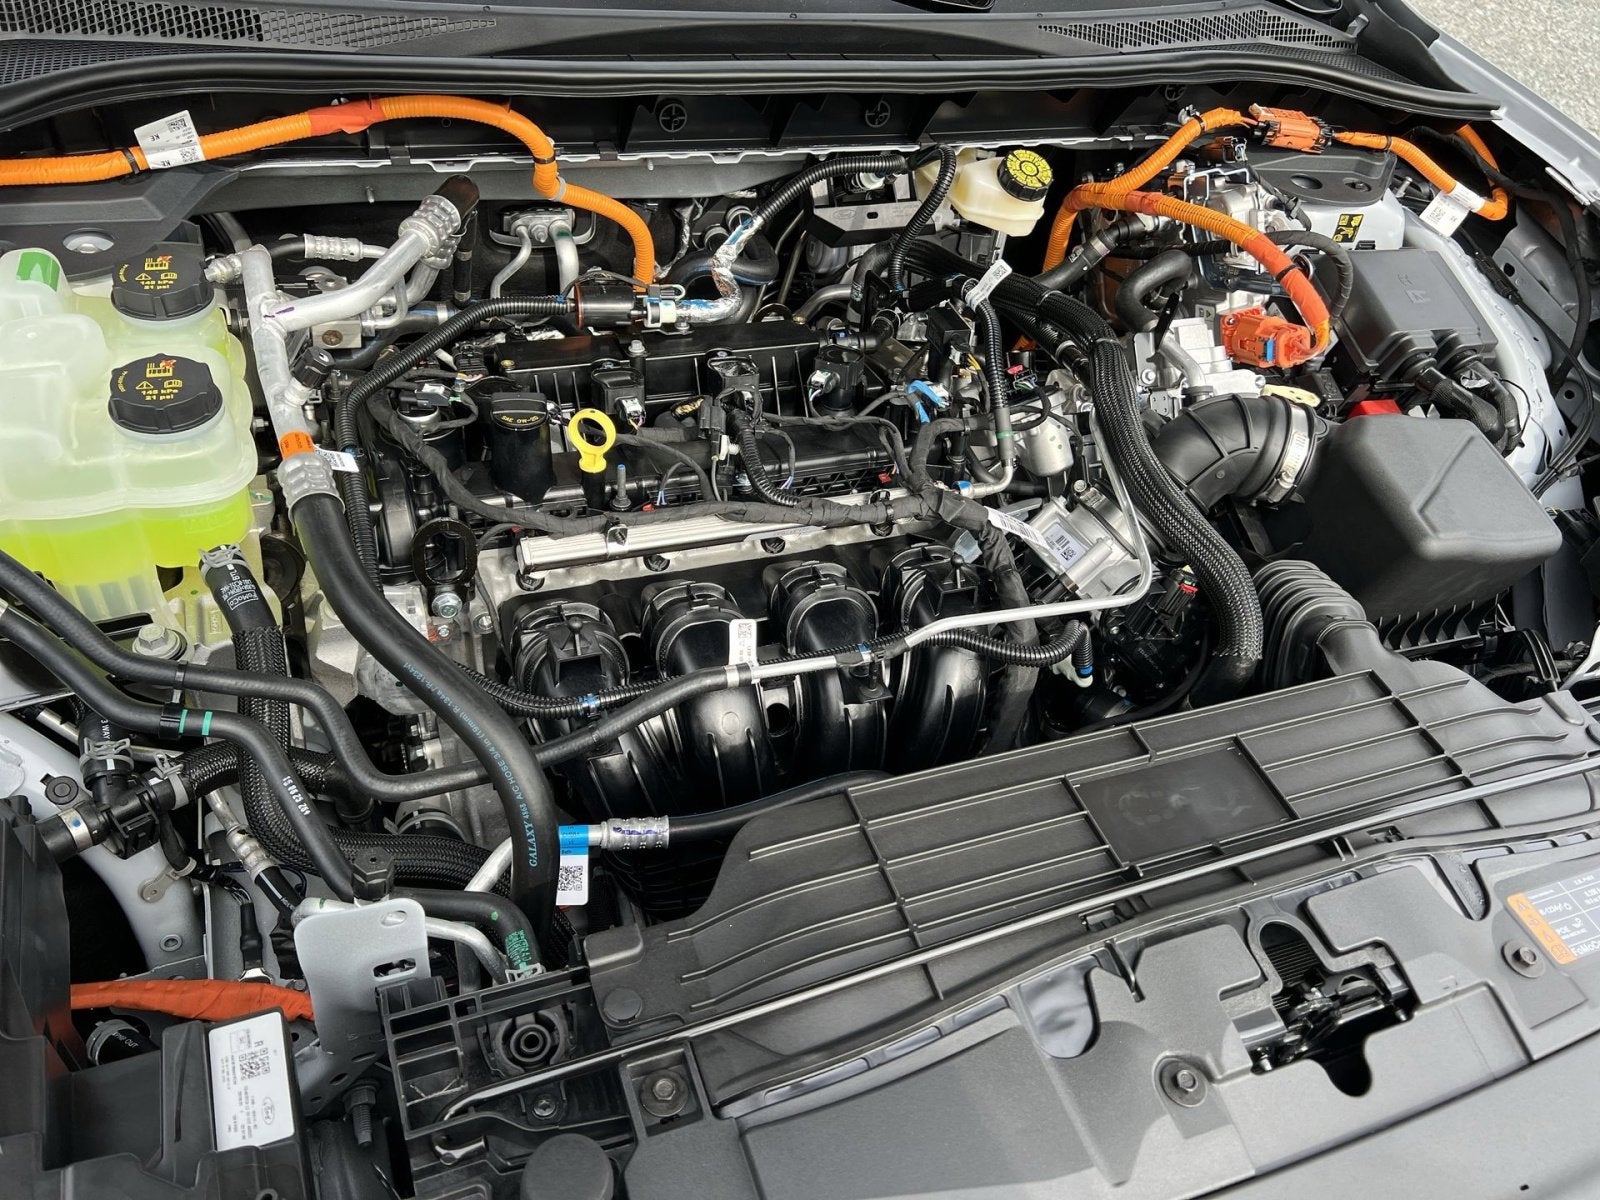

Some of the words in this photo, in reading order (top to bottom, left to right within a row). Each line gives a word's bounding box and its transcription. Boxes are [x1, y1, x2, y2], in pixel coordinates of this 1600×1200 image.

[501, 415, 514, 423] SAE
[230, 592, 259, 607] FoMoCo
[101, 724, 110, 739] WAY
[460, 712, 485, 740] (19mm)
[497, 760, 516, 785] HOSE
[512, 785, 524, 801] A/C
[524, 821, 538, 867] GALAXY
